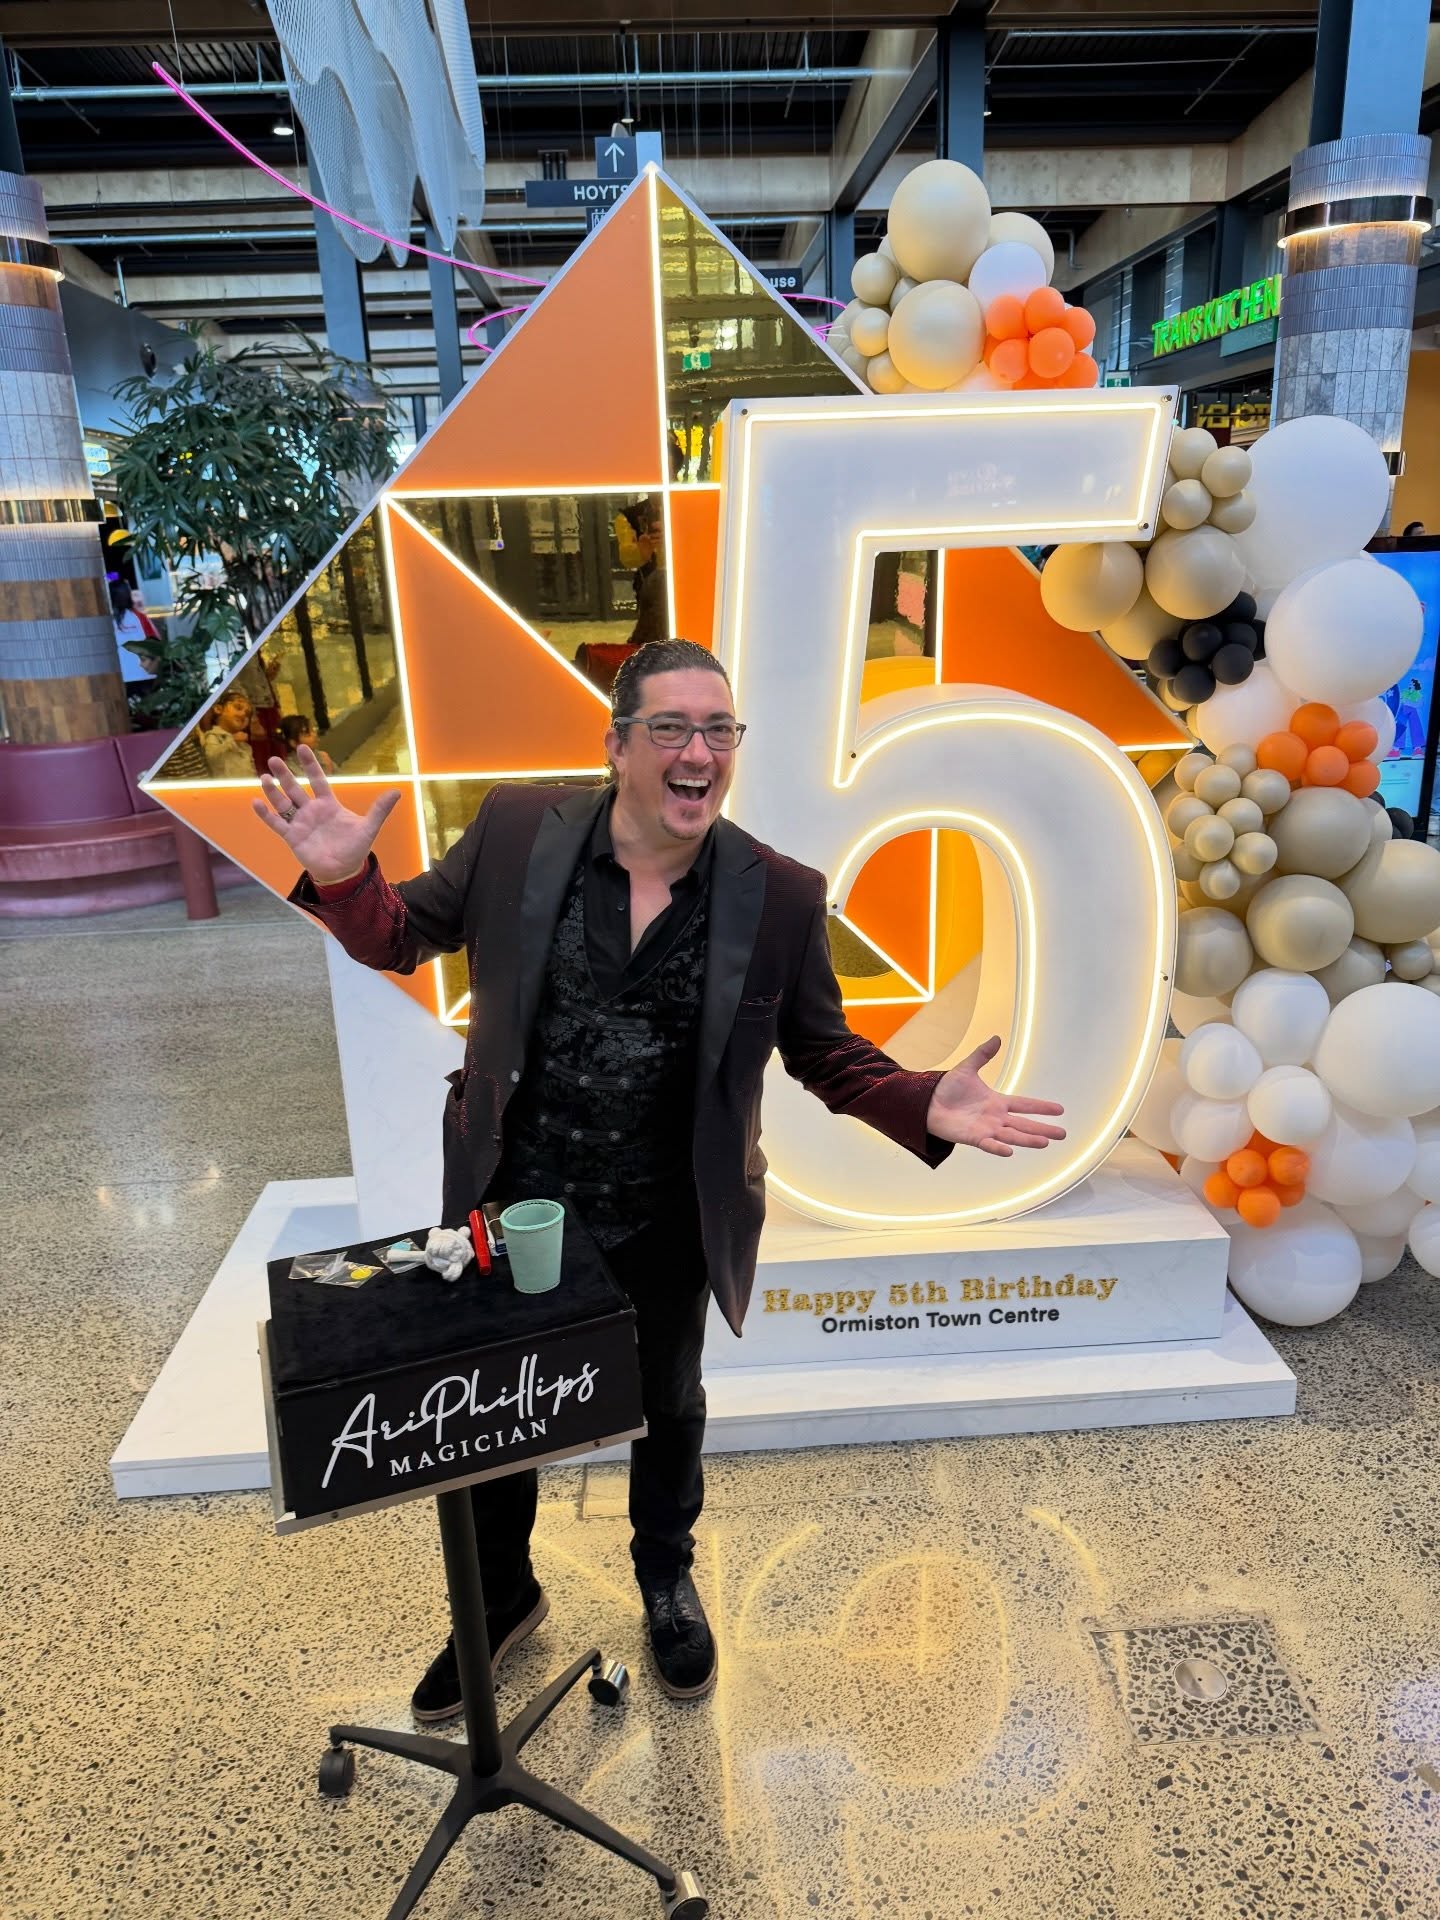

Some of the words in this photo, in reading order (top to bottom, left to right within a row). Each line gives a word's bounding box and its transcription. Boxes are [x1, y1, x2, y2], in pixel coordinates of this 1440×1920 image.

[768, 276, 797, 288] use
[720, 386, 1178, 1231] 5
[762, 1287, 876, 1316] Happy
[888, 1280, 949, 1307] 5th
[960, 1273, 1118, 1301] Birthday
[821, 1315, 919, 1334] Ormiston
[926, 1311, 981, 1328] Town
[988, 1307, 1060, 1325] Centre
[389, 1418, 548, 1477] MAGICIAN
